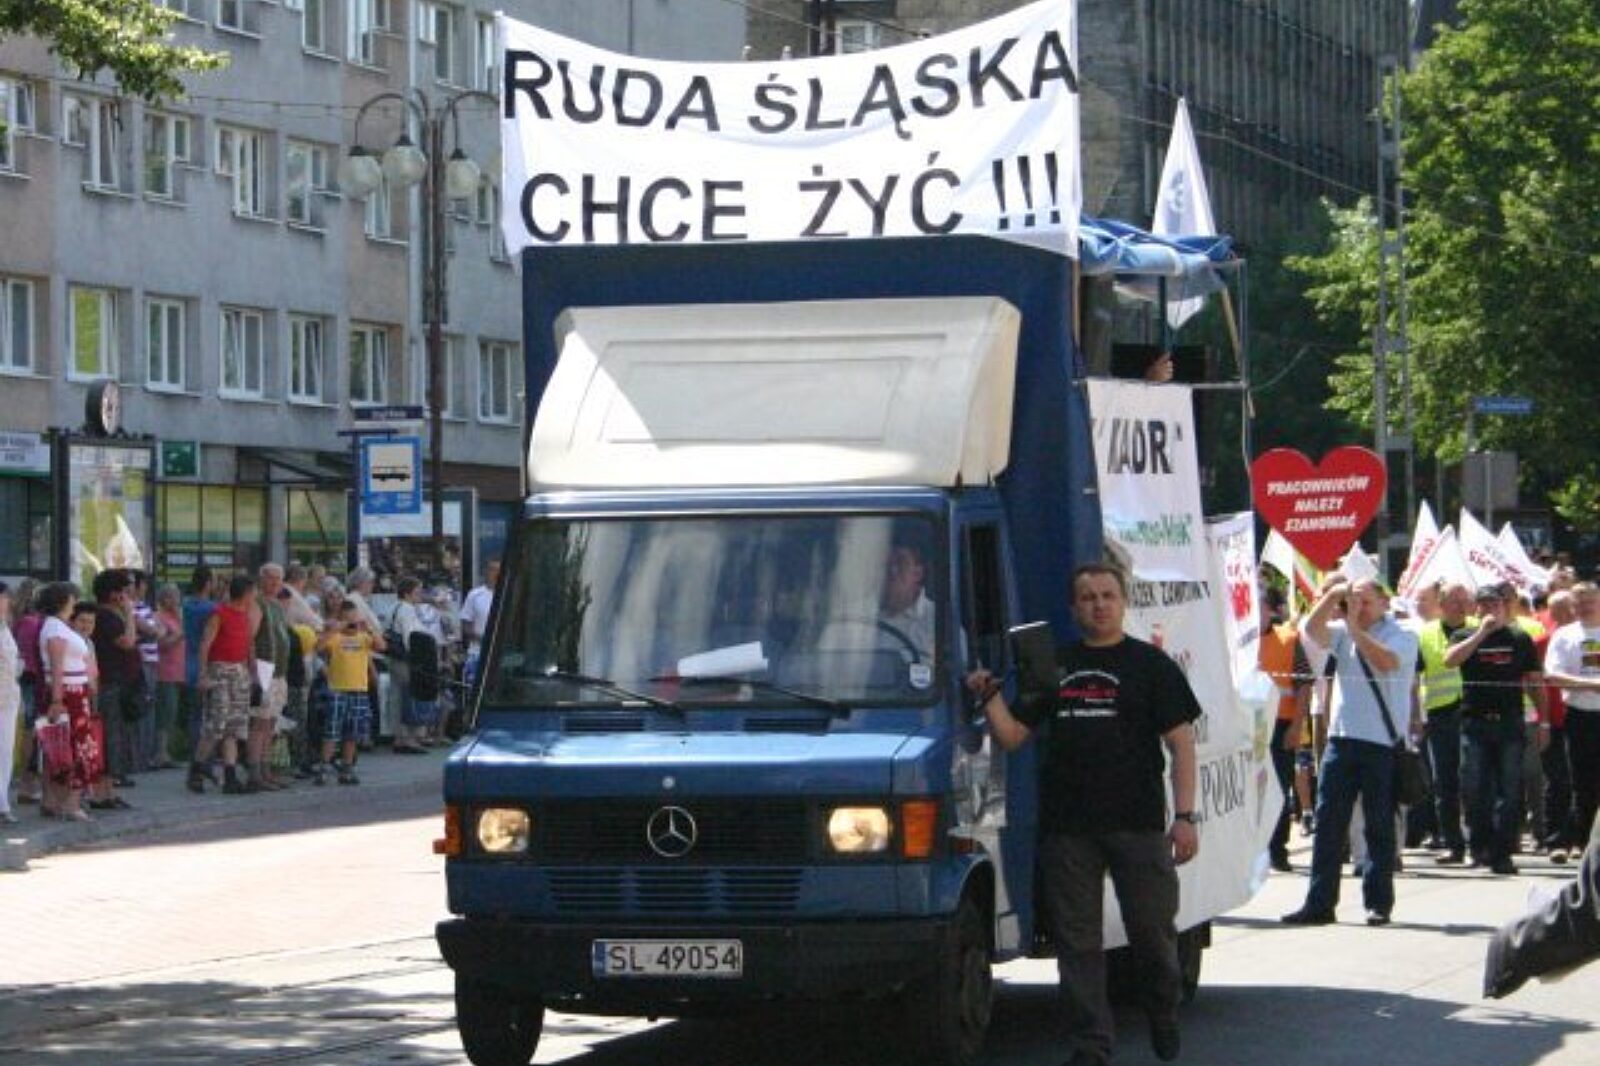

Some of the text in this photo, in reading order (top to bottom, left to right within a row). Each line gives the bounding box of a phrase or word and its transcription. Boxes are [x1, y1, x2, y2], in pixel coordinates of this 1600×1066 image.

[503, 30, 1079, 140] RUDA ŚLĄSKA
[520, 151, 1061, 243] CHCE ŻYĆ !!!
[1266, 474, 1370, 496] PRACOWNIKÓW
[1294, 496, 1344, 512] NALEŻY
[609, 946, 737, 971] SL 49054
